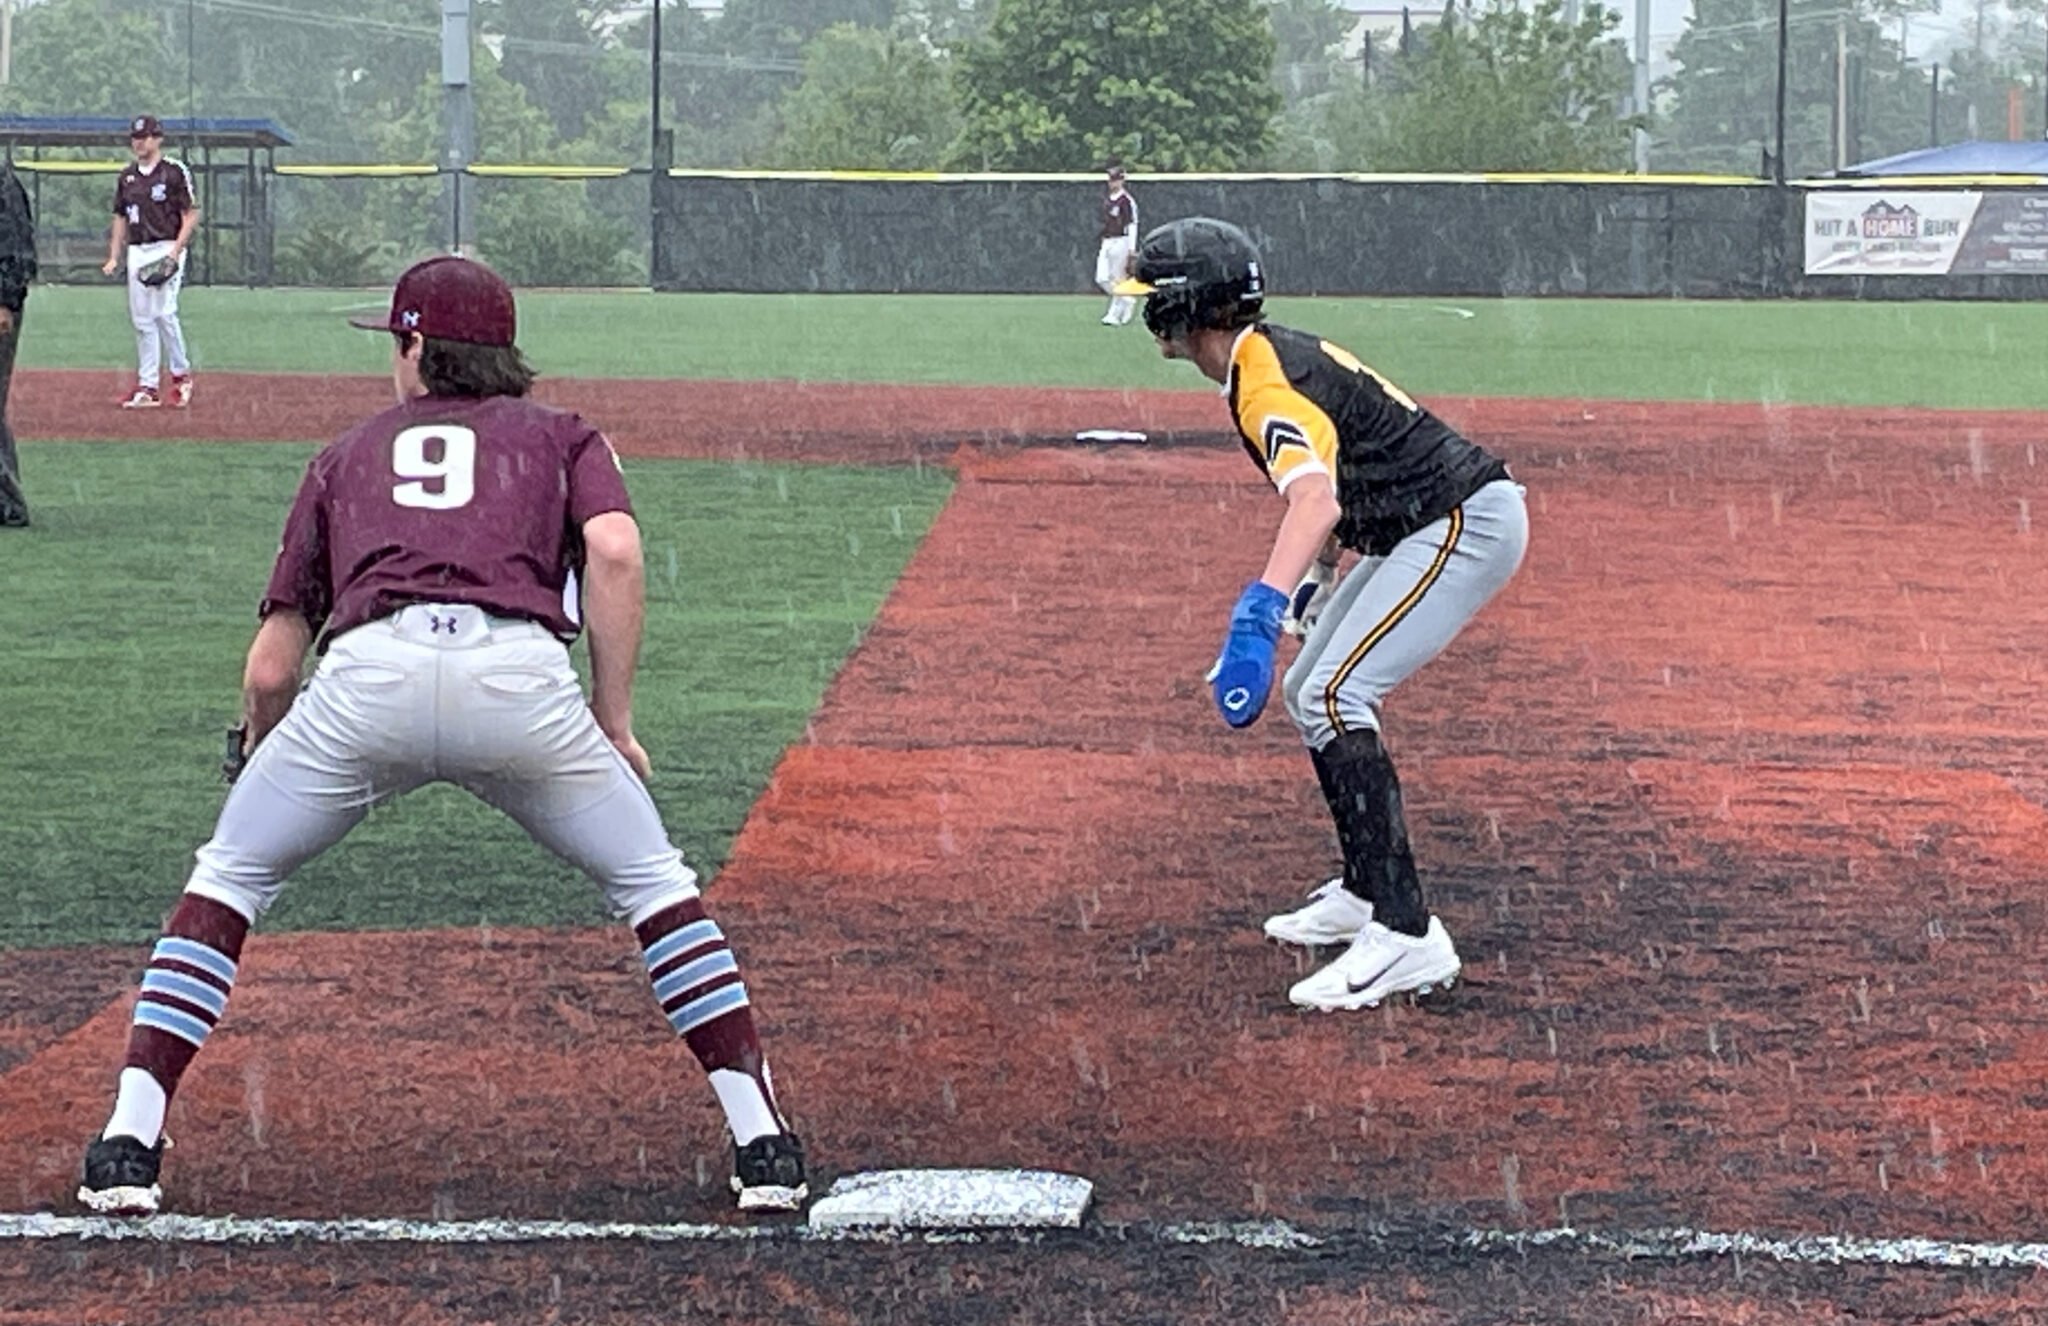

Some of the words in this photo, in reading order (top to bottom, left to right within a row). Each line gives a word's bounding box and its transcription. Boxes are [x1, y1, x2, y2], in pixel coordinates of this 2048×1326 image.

[1814, 220, 1842, 236] HIT
[1846, 220, 1858, 236] A
[1865, 219, 1916, 236] HOME
[1924, 219, 1959, 236] RUN
[393, 425, 476, 509] 9
